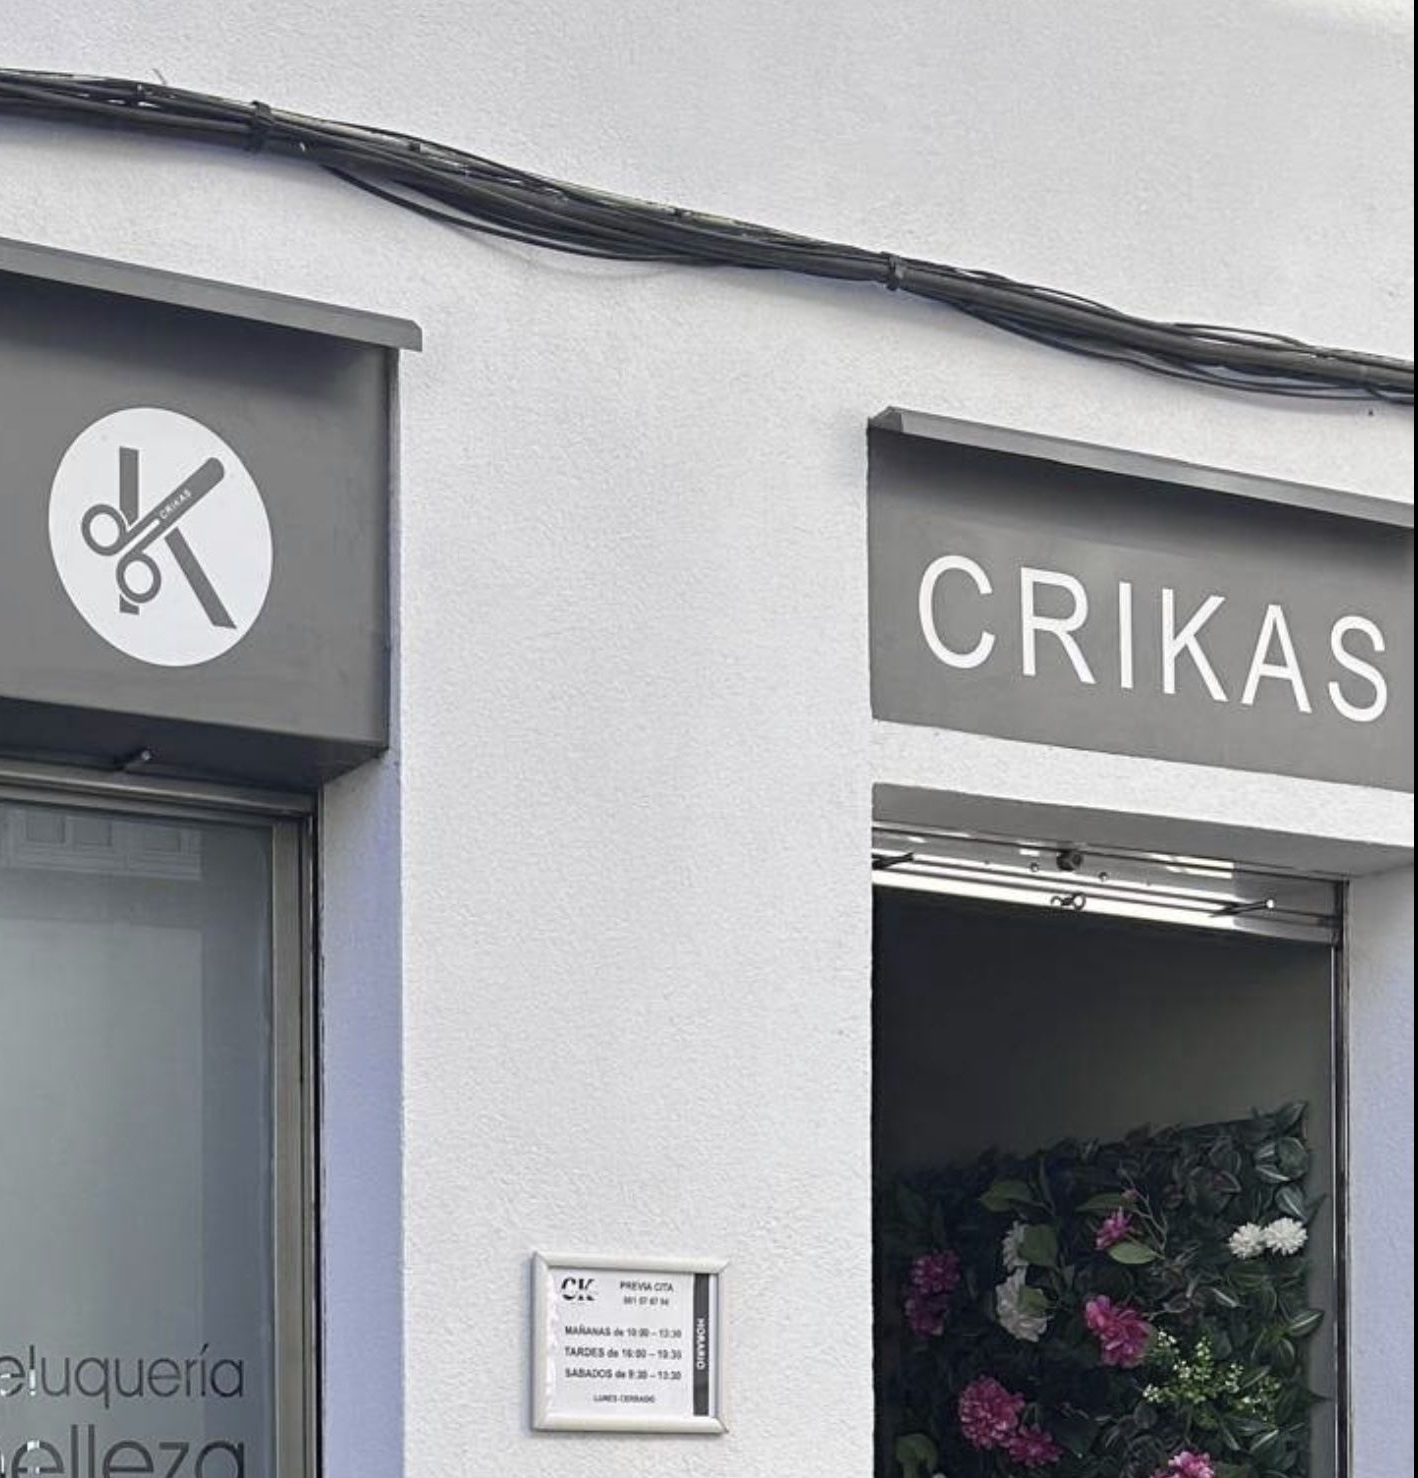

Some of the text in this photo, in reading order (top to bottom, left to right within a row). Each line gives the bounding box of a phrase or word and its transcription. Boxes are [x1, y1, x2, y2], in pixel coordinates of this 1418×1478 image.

[158, 488, 193, 520] CRIKAS
[918, 555, 1388, 722] CRIKAS
[620, 1281, 675, 1293] PREVIA CITA
[564, 1324, 611, 1337] MAÑANAS
[613, 1327, 623, 1337] de
[696, 1317, 706, 1371] HORARIO
[564, 1347, 605, 1358] TARDES
[607, 1348, 619, 1358] de
[615, 1369, 625, 1379] de
